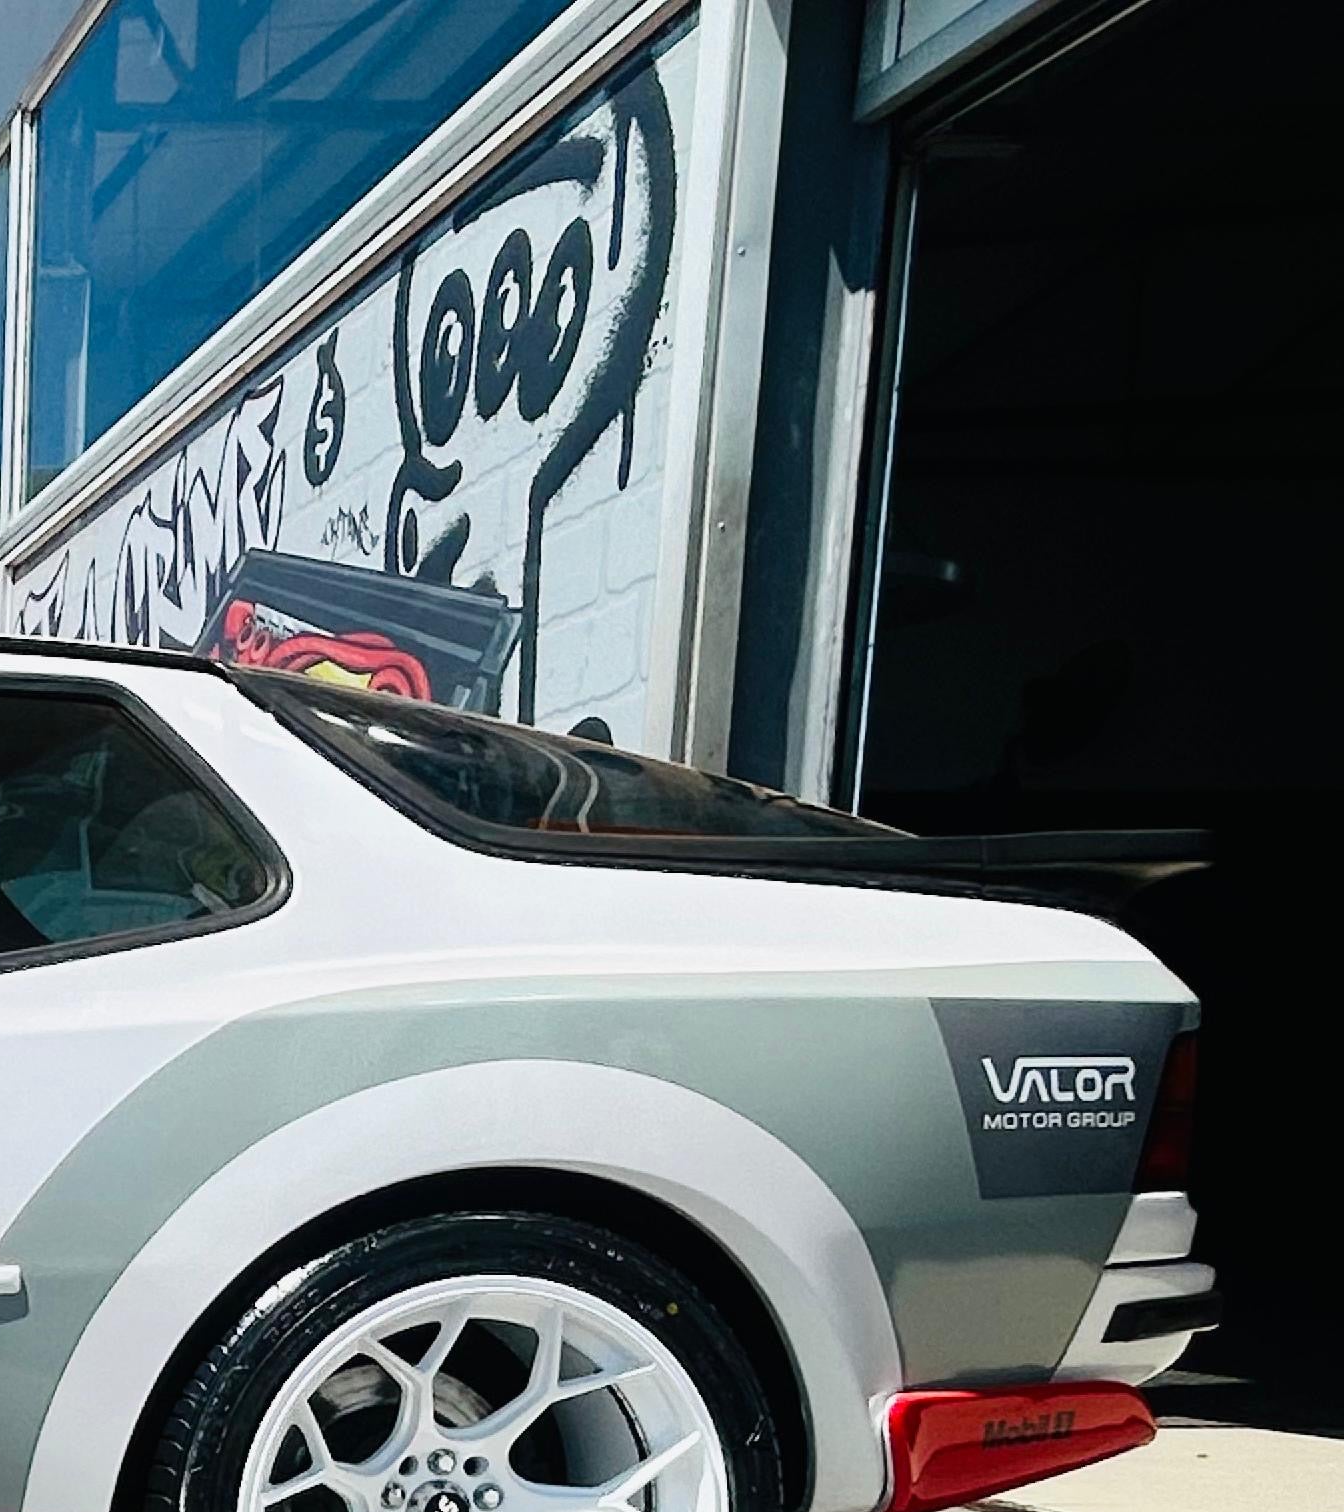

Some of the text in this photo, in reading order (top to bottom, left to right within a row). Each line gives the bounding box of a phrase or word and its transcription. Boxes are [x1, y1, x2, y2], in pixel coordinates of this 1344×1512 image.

[981, 1056, 1136, 1103] VALOR
[983, 1111, 1136, 1130] MOTOR GROUP
